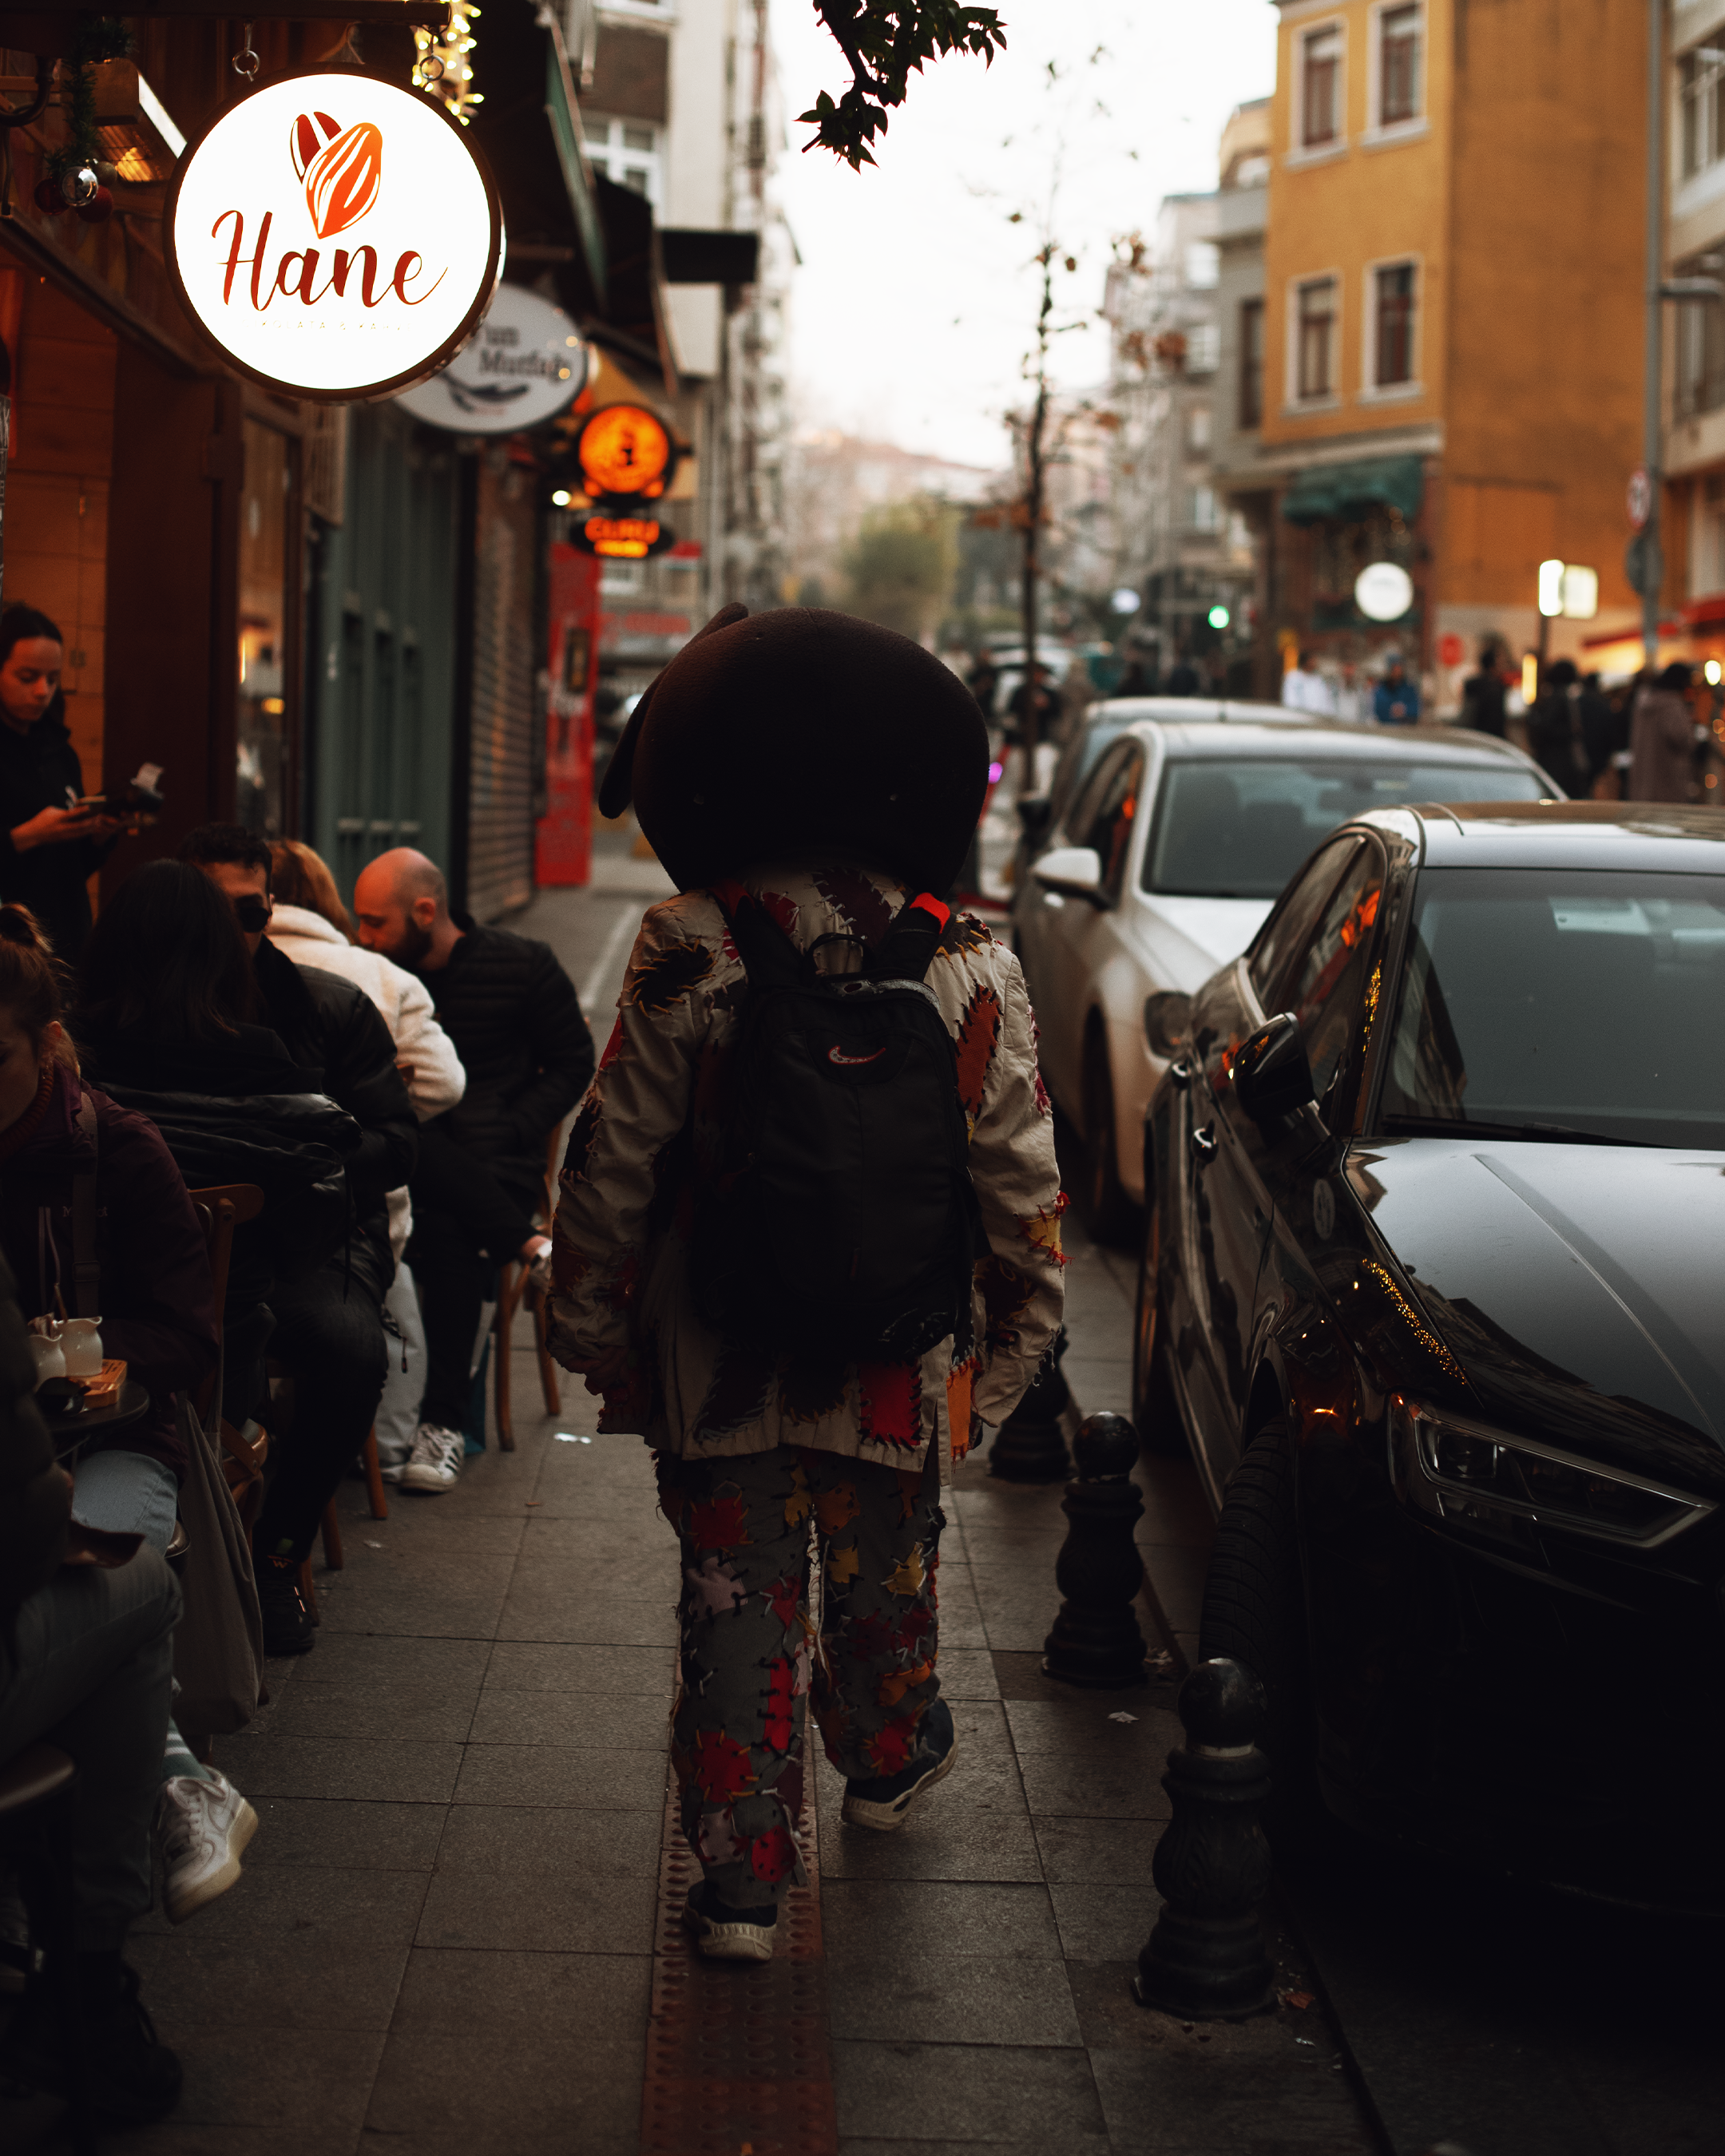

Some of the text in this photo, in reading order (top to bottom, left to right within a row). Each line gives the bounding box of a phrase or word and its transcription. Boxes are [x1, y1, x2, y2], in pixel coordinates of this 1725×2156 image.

[212, 210, 449, 311] Hane
[358, 321, 413, 332] KAHVE
[61, 1205, 109, 1218] Mot
